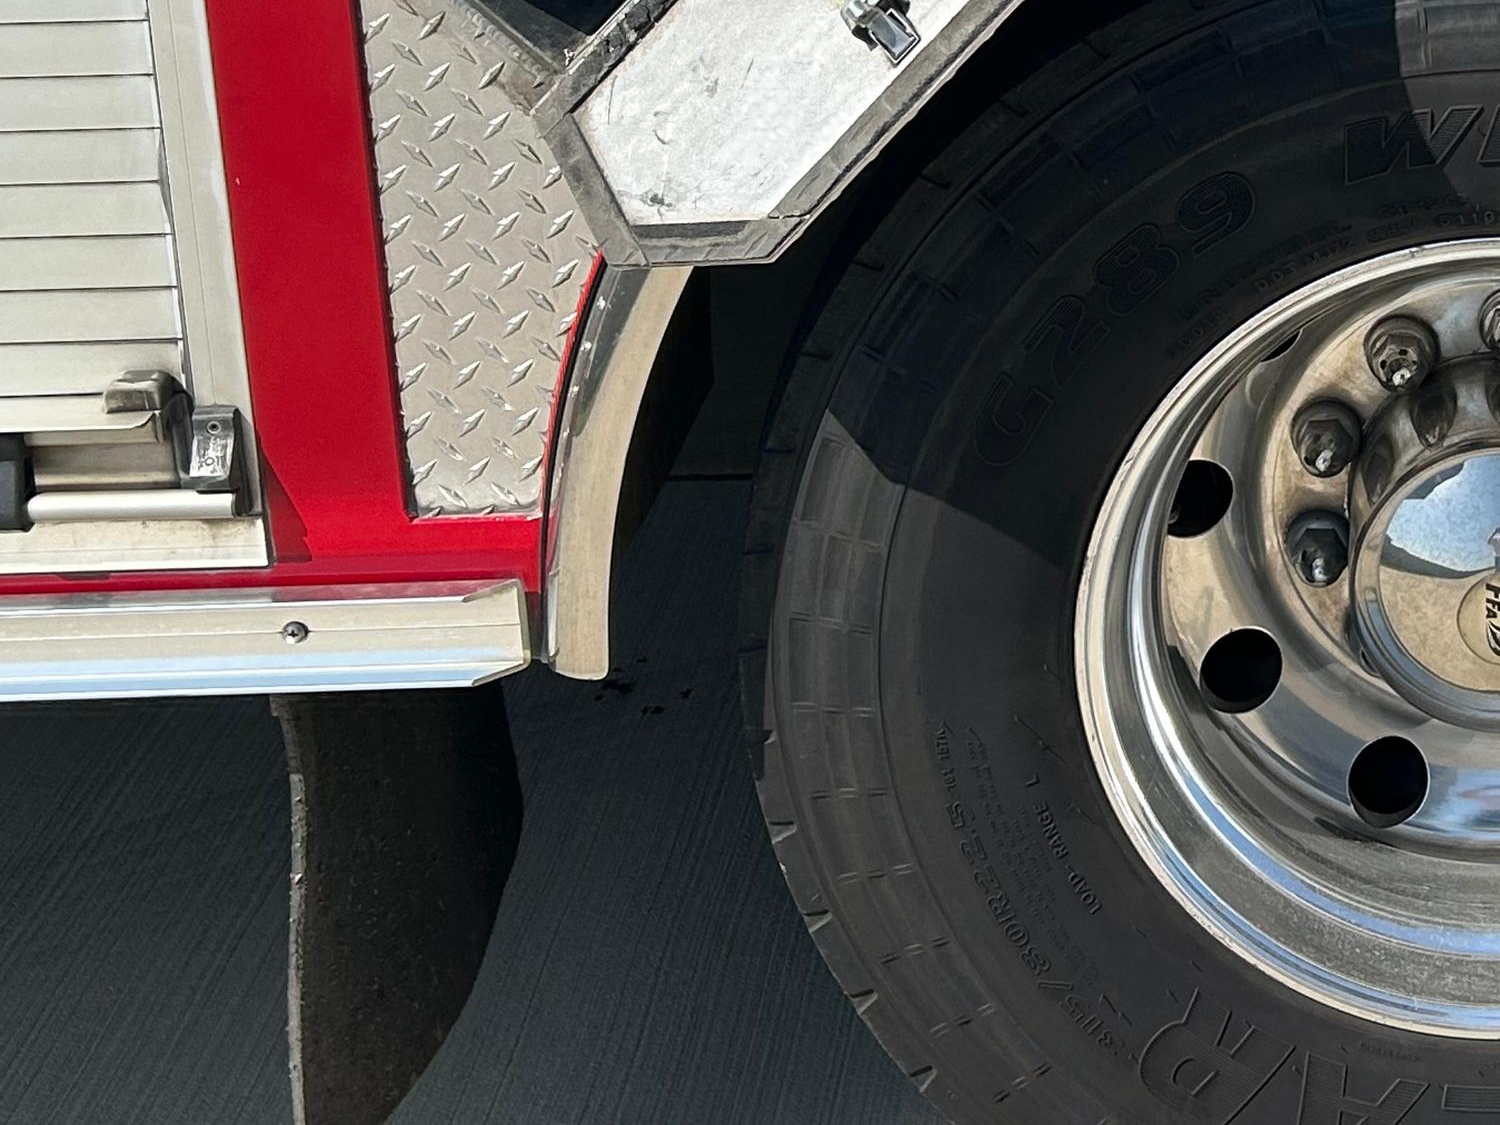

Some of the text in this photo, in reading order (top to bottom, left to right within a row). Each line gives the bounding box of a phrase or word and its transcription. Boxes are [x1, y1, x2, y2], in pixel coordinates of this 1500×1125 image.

[974, 170, 1256, 467] G289
[1024, 772, 1041, 790] L
[1032, 799, 1069, 862] RANGE
